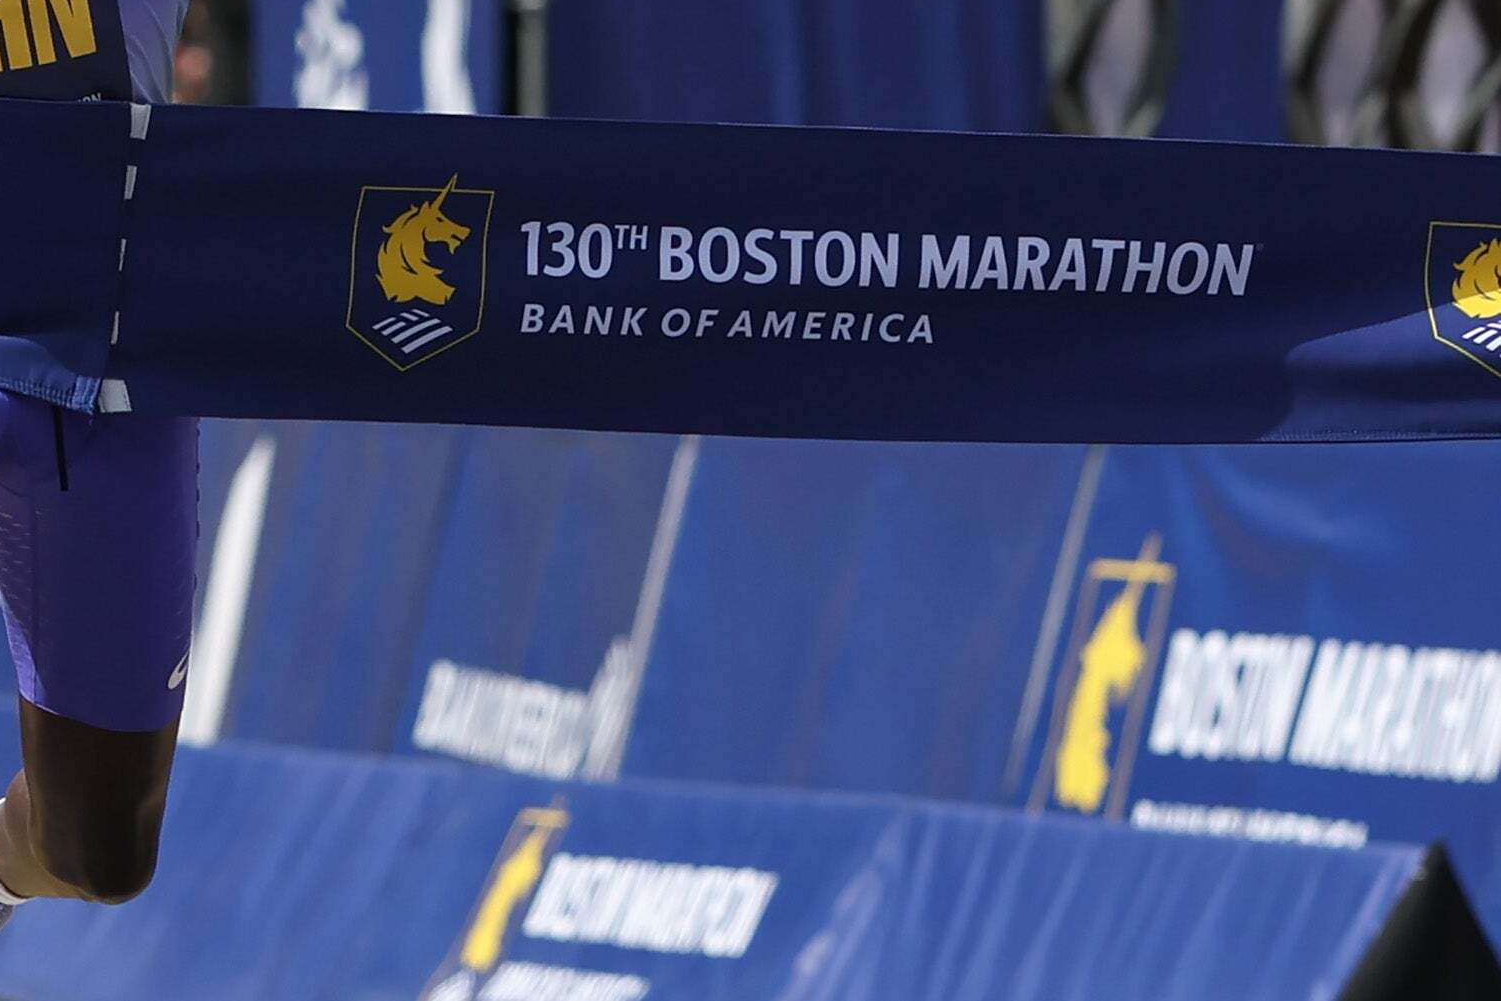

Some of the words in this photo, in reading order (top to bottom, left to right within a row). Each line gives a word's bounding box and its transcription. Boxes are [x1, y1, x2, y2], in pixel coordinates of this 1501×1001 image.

[520, 221, 648, 279] 130TH
[659, 226, 900, 288] BOSTON
[918, 234, 1255, 296] MARATHON
[520, 303, 648, 336] BANK
[661, 308, 719, 338] OF
[727, 310, 934, 344] AMERICA
